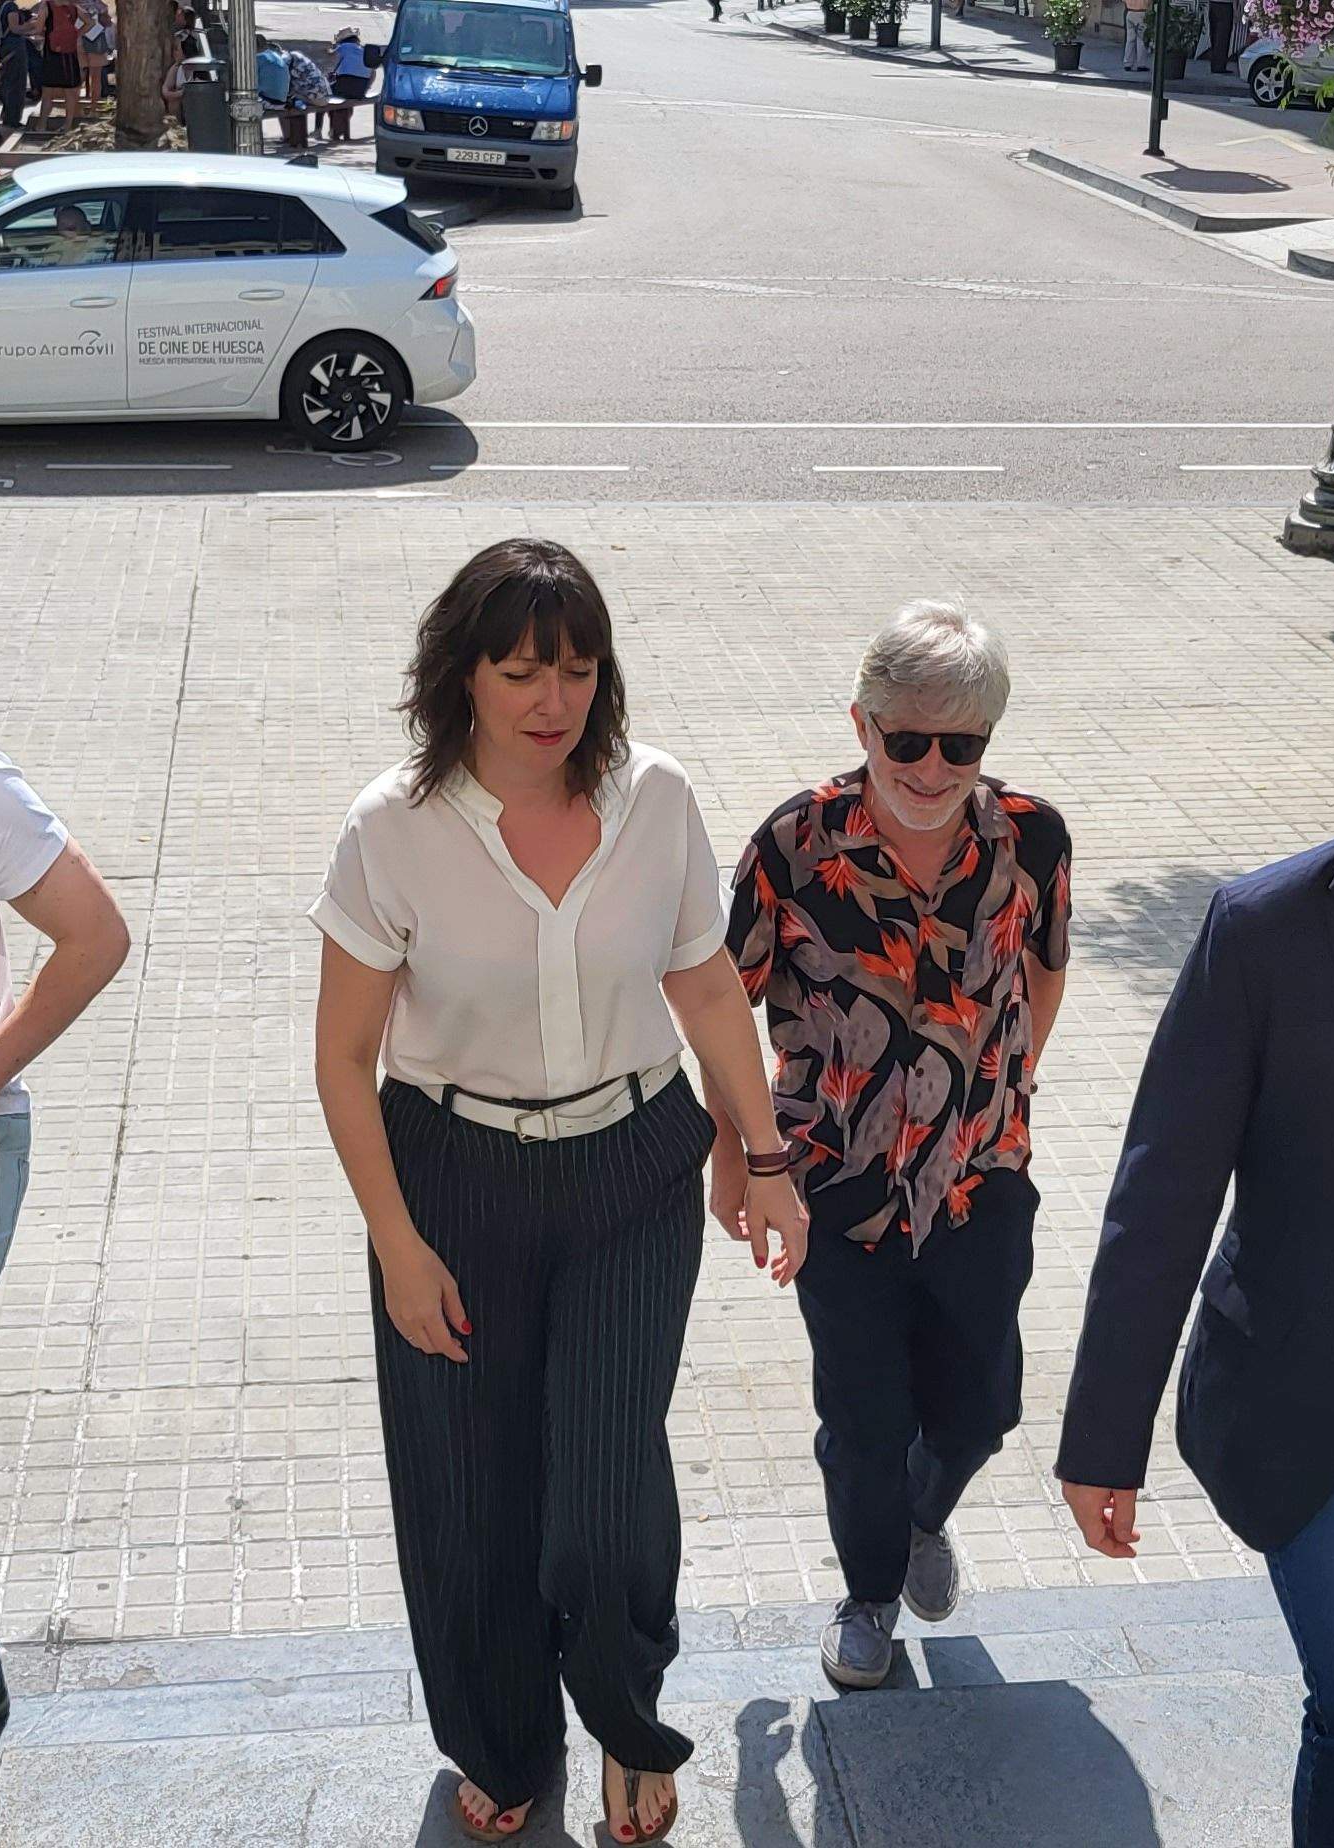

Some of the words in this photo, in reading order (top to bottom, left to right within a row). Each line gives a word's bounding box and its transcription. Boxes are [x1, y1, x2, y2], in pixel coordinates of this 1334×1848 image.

[455, 150, 480, 161] 2293
[138, 326, 183, 339] FESTIVAL
[185, 319, 264, 335] INTERNACIONAL
[138, 341, 156, 355] DE
[159, 341, 189, 355] CINE
[192, 341, 209, 354] DE
[212, 340, 265, 354] HUESCA
[138, 357, 165, 366] HUESCA
[167, 357, 217, 365] INTERNATIONAL
[219, 357, 234, 365] FILM
[236, 357, 265, 365] FESTIVAL
